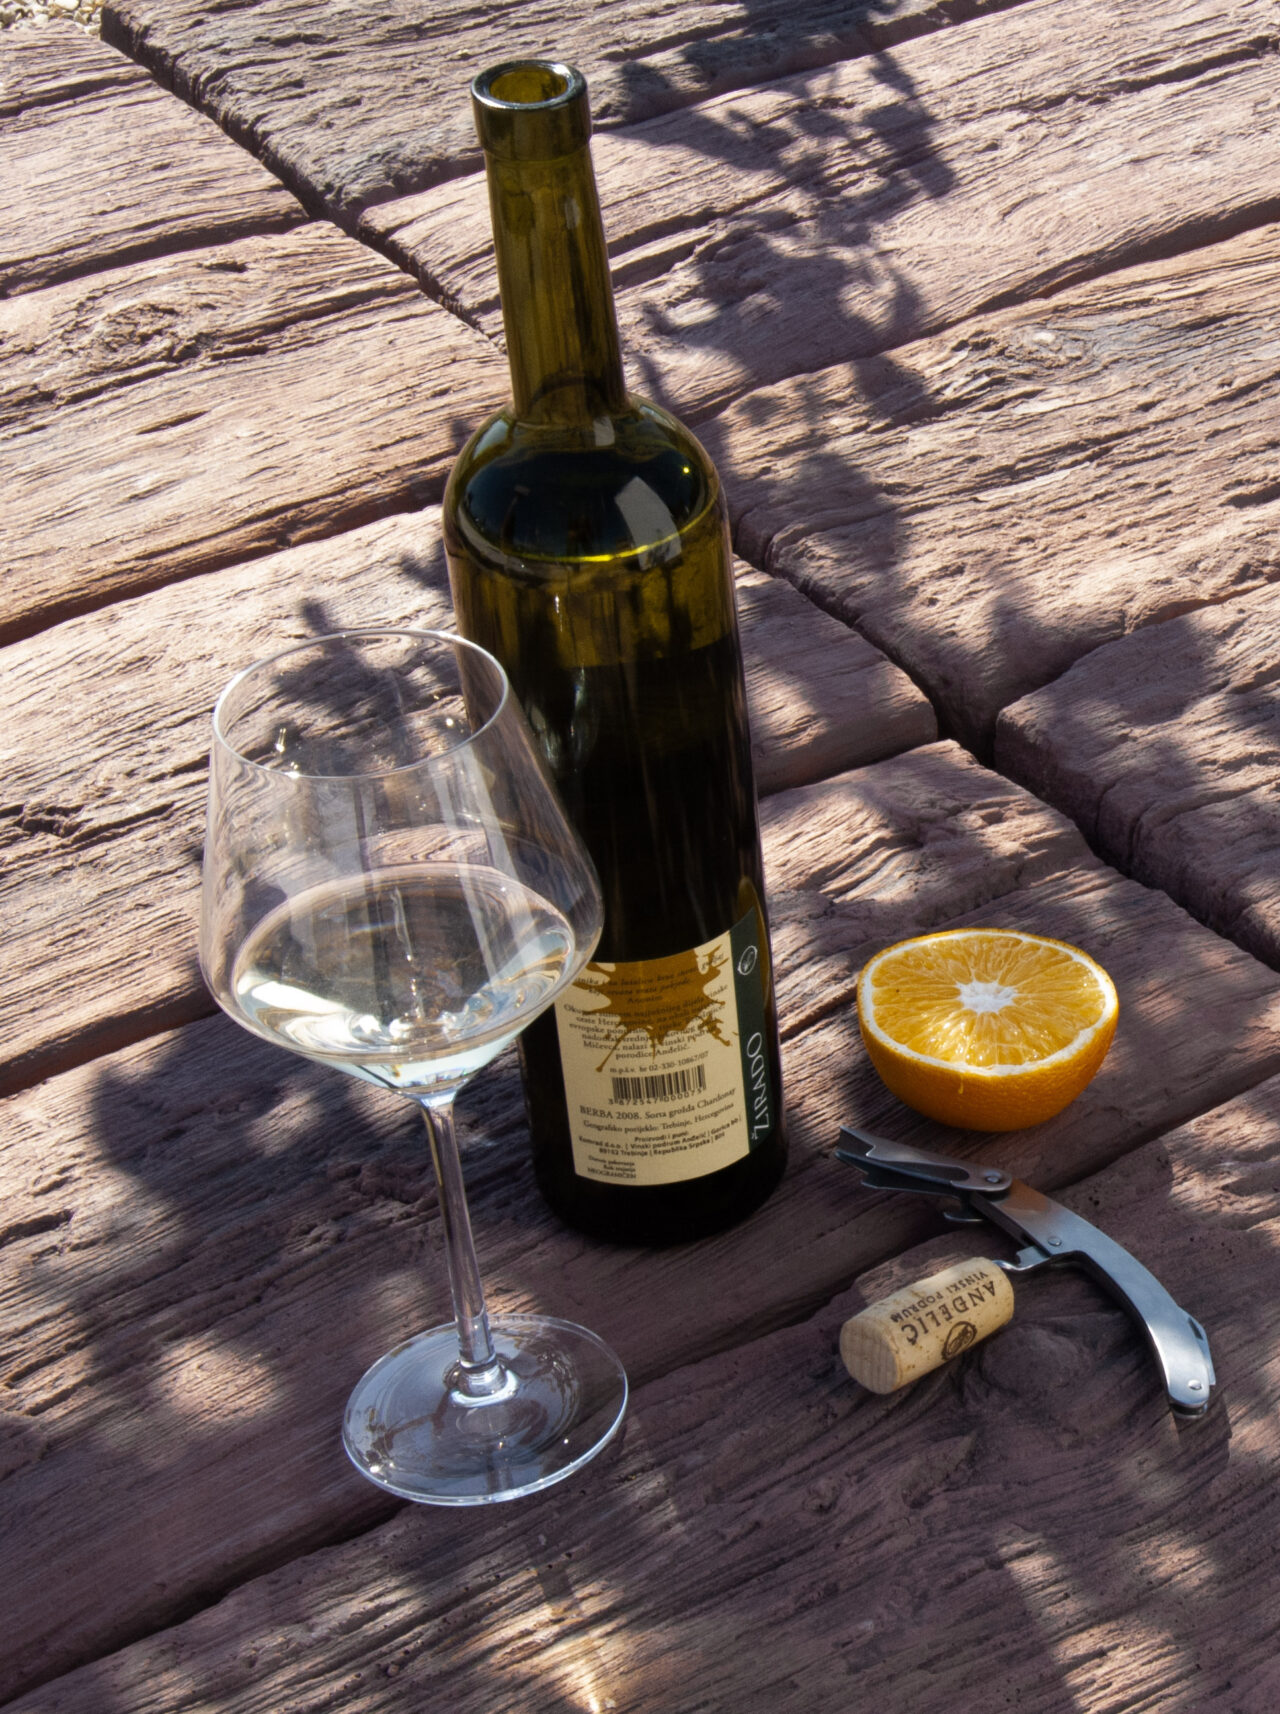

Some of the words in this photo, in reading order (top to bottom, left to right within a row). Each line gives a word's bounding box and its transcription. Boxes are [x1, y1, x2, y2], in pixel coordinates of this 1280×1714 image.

[622, 1042, 648, 1050] nalazi
[616, 1050, 653, 1060] porodice
[579, 1105, 613, 1119] BERBA
[616, 1111, 642, 1120] 2008.
[645, 1111, 667, 1119] Sorta
[945, 1271, 988, 1294] VINSKI
[890, 1291, 944, 1323] PODRUM
